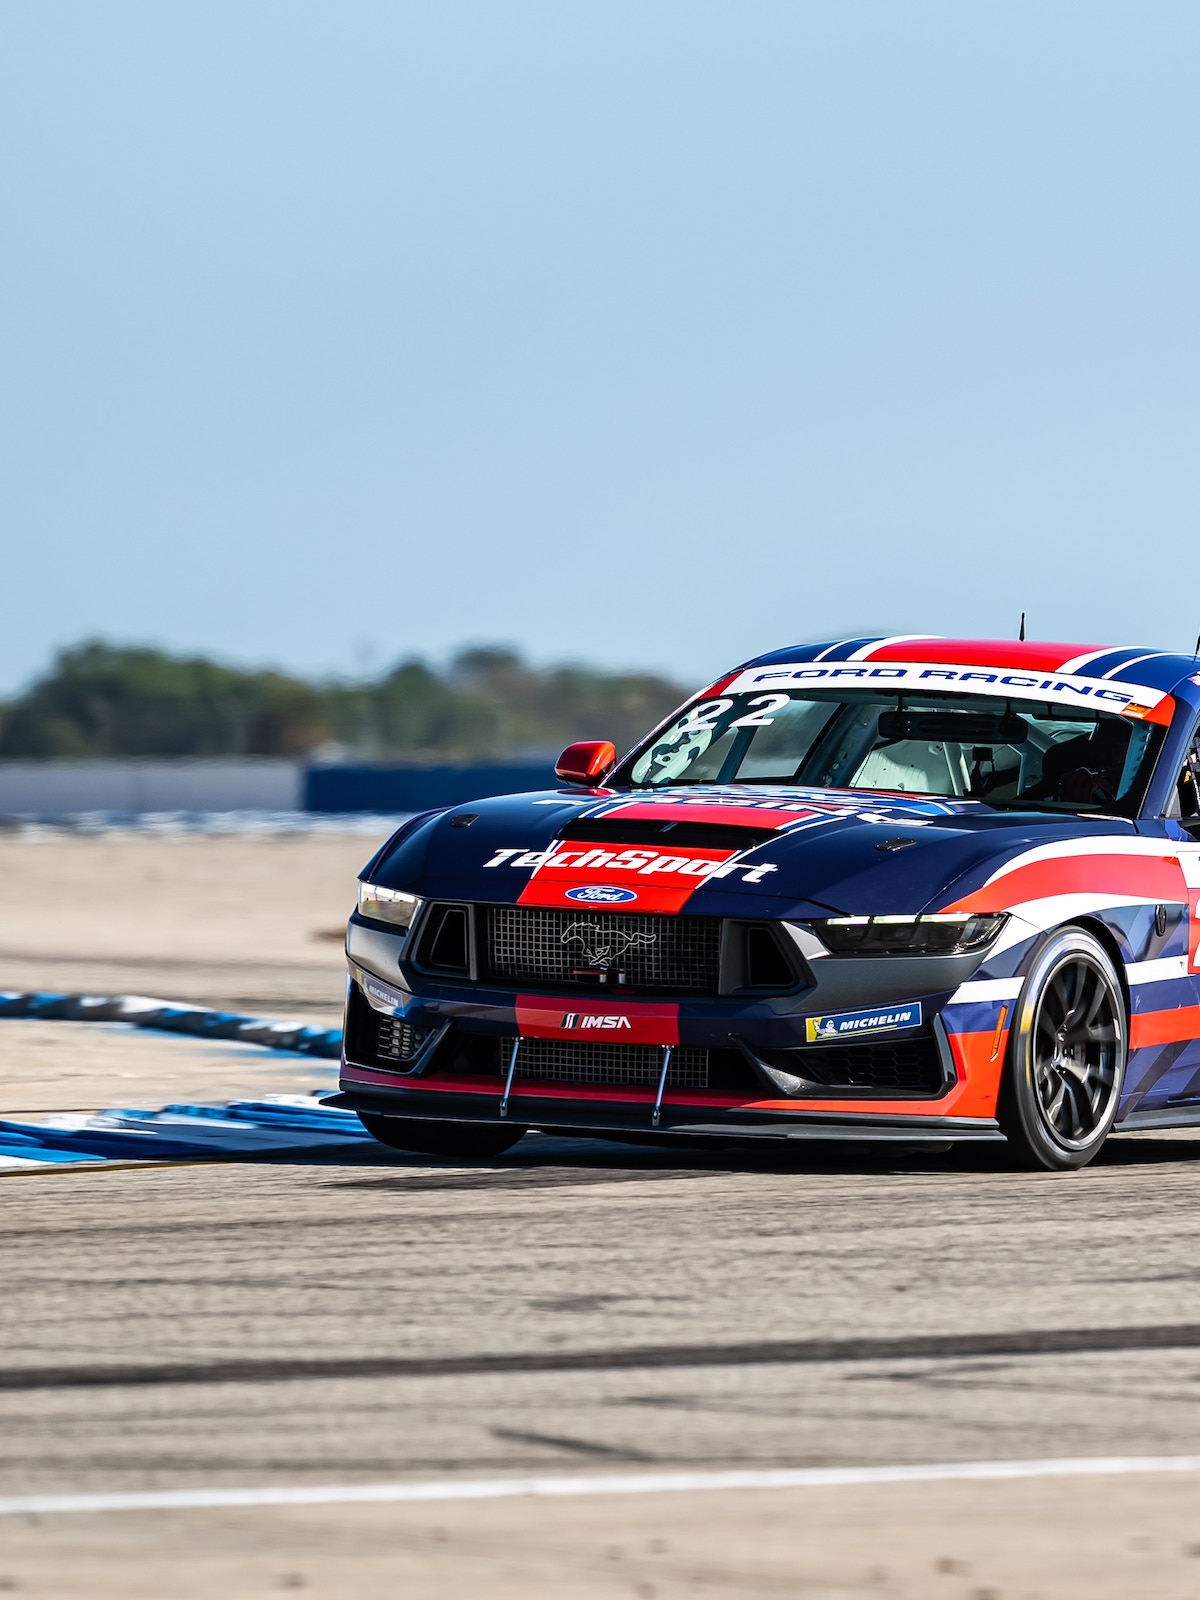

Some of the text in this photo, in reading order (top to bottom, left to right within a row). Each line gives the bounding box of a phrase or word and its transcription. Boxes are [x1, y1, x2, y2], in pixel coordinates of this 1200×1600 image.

[752, 668, 1134, 704] FORD RACING
[674, 693, 790, 733] 22
[482, 848, 778, 883] TechSport
[575, 886, 625, 901] Ford
[368, 985, 399, 1007] MICHELIN
[581, 1015, 632, 1029] IMSA
[839, 1011, 912, 1031] MICHELIN
